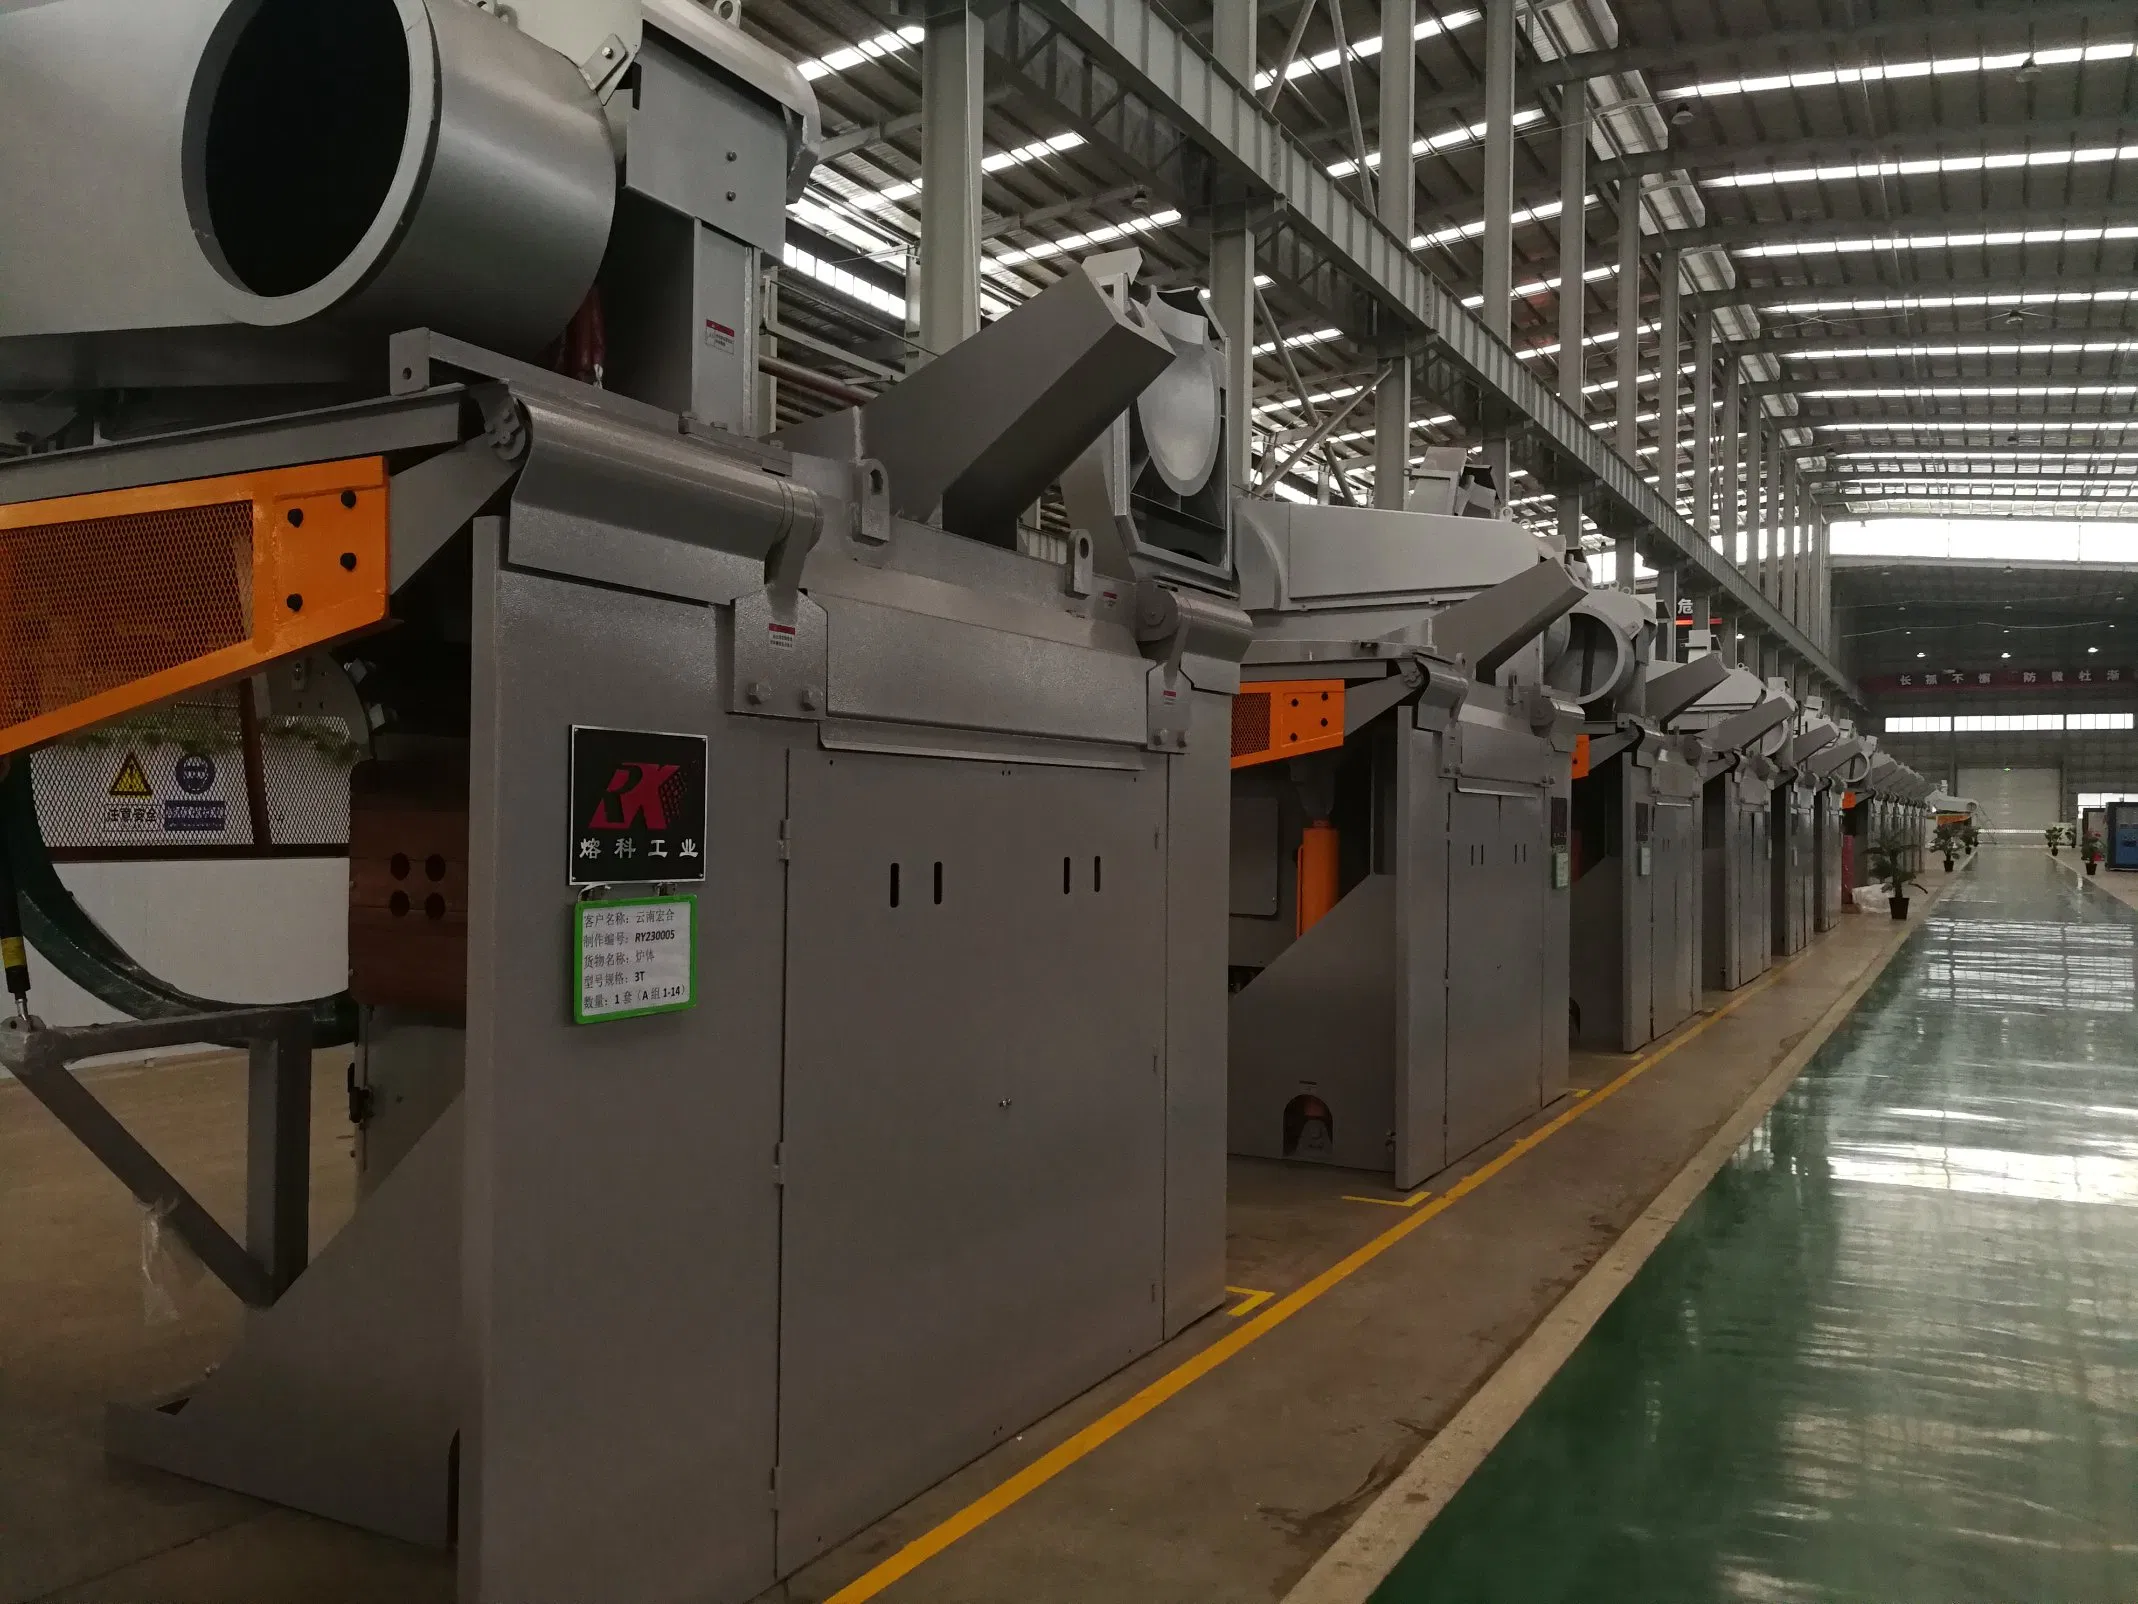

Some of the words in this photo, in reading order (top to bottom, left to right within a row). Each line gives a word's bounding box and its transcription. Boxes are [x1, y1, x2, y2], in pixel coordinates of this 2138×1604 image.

[1677, 598, 1693, 614] 危
[579, 837, 699, 859] 熔科工业
